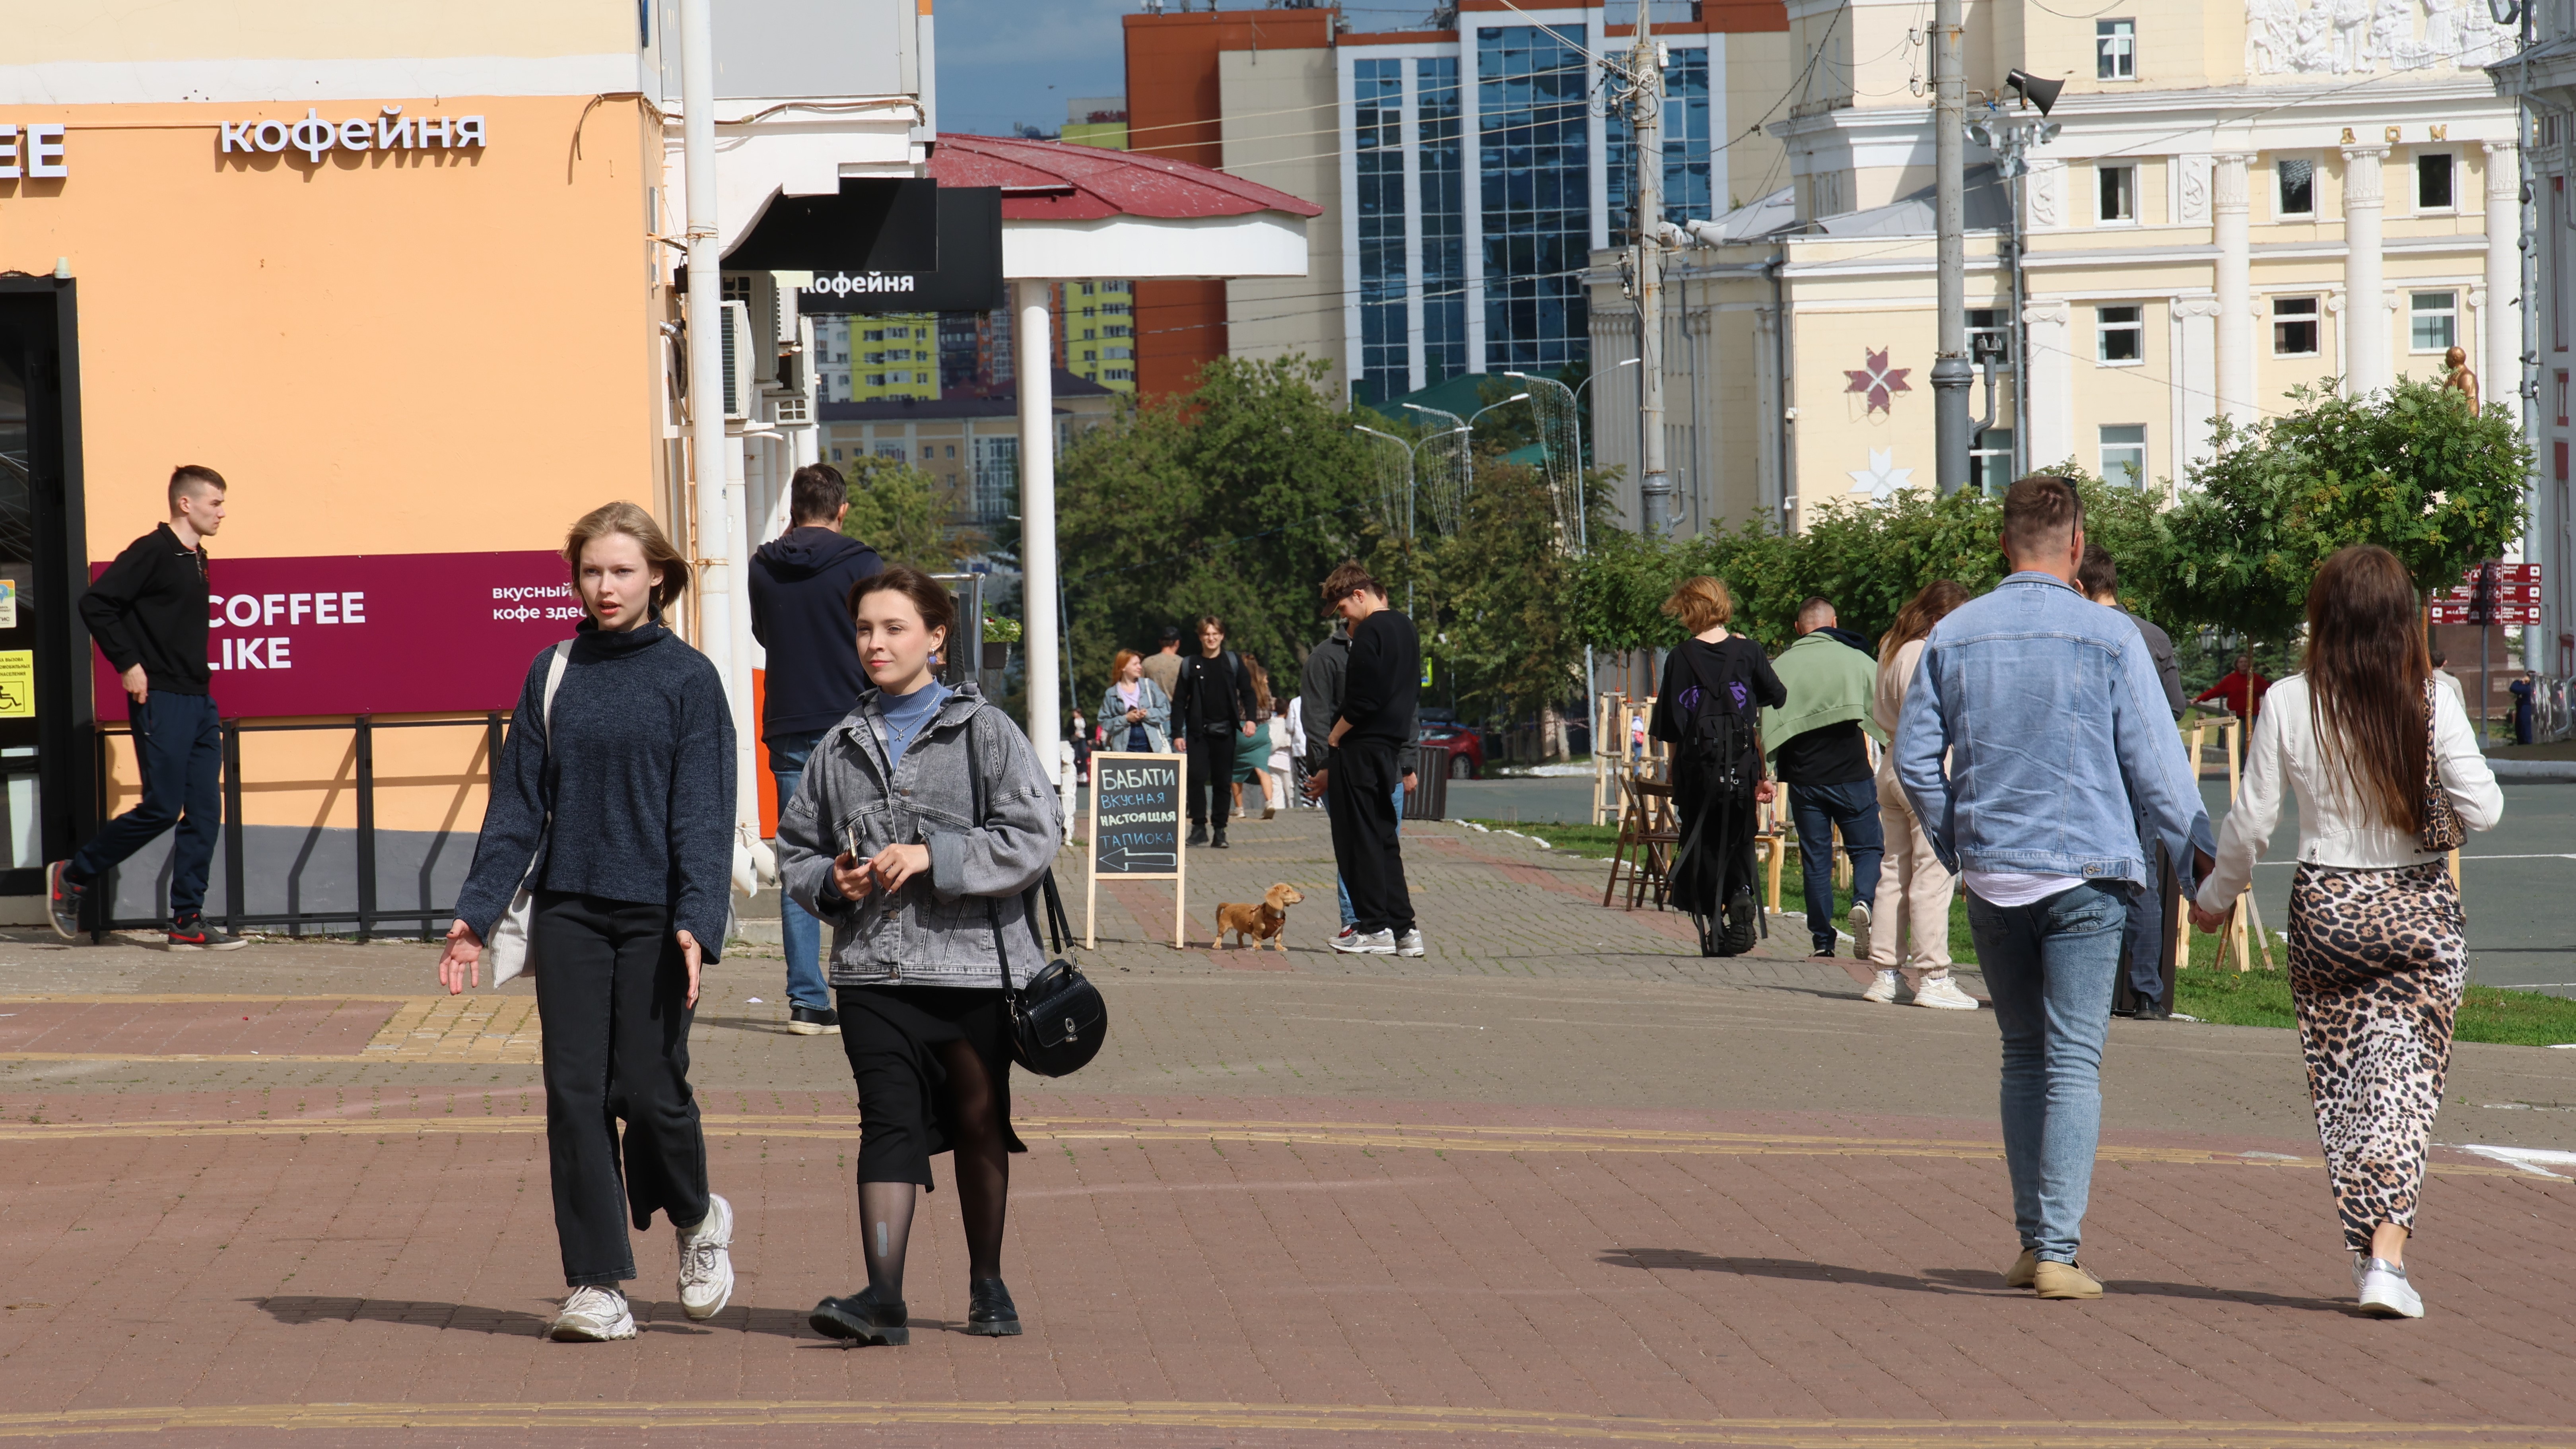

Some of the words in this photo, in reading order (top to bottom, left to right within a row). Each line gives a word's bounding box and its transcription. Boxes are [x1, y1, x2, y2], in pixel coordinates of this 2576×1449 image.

[221, 105, 486, 162] кофейня
[2341, 124, 2447, 144] ДОМ
[492, 582, 573, 602] вкусный
[208, 592, 366, 628] COFFEE
[493, 604, 541, 623] кофе
[1100, 792, 1165, 809] ВКУСНАЯ
[1100, 811, 1176, 827] НАСТОЯЩАЯ
[1099, 832, 1175, 849] ТАПИОКА
